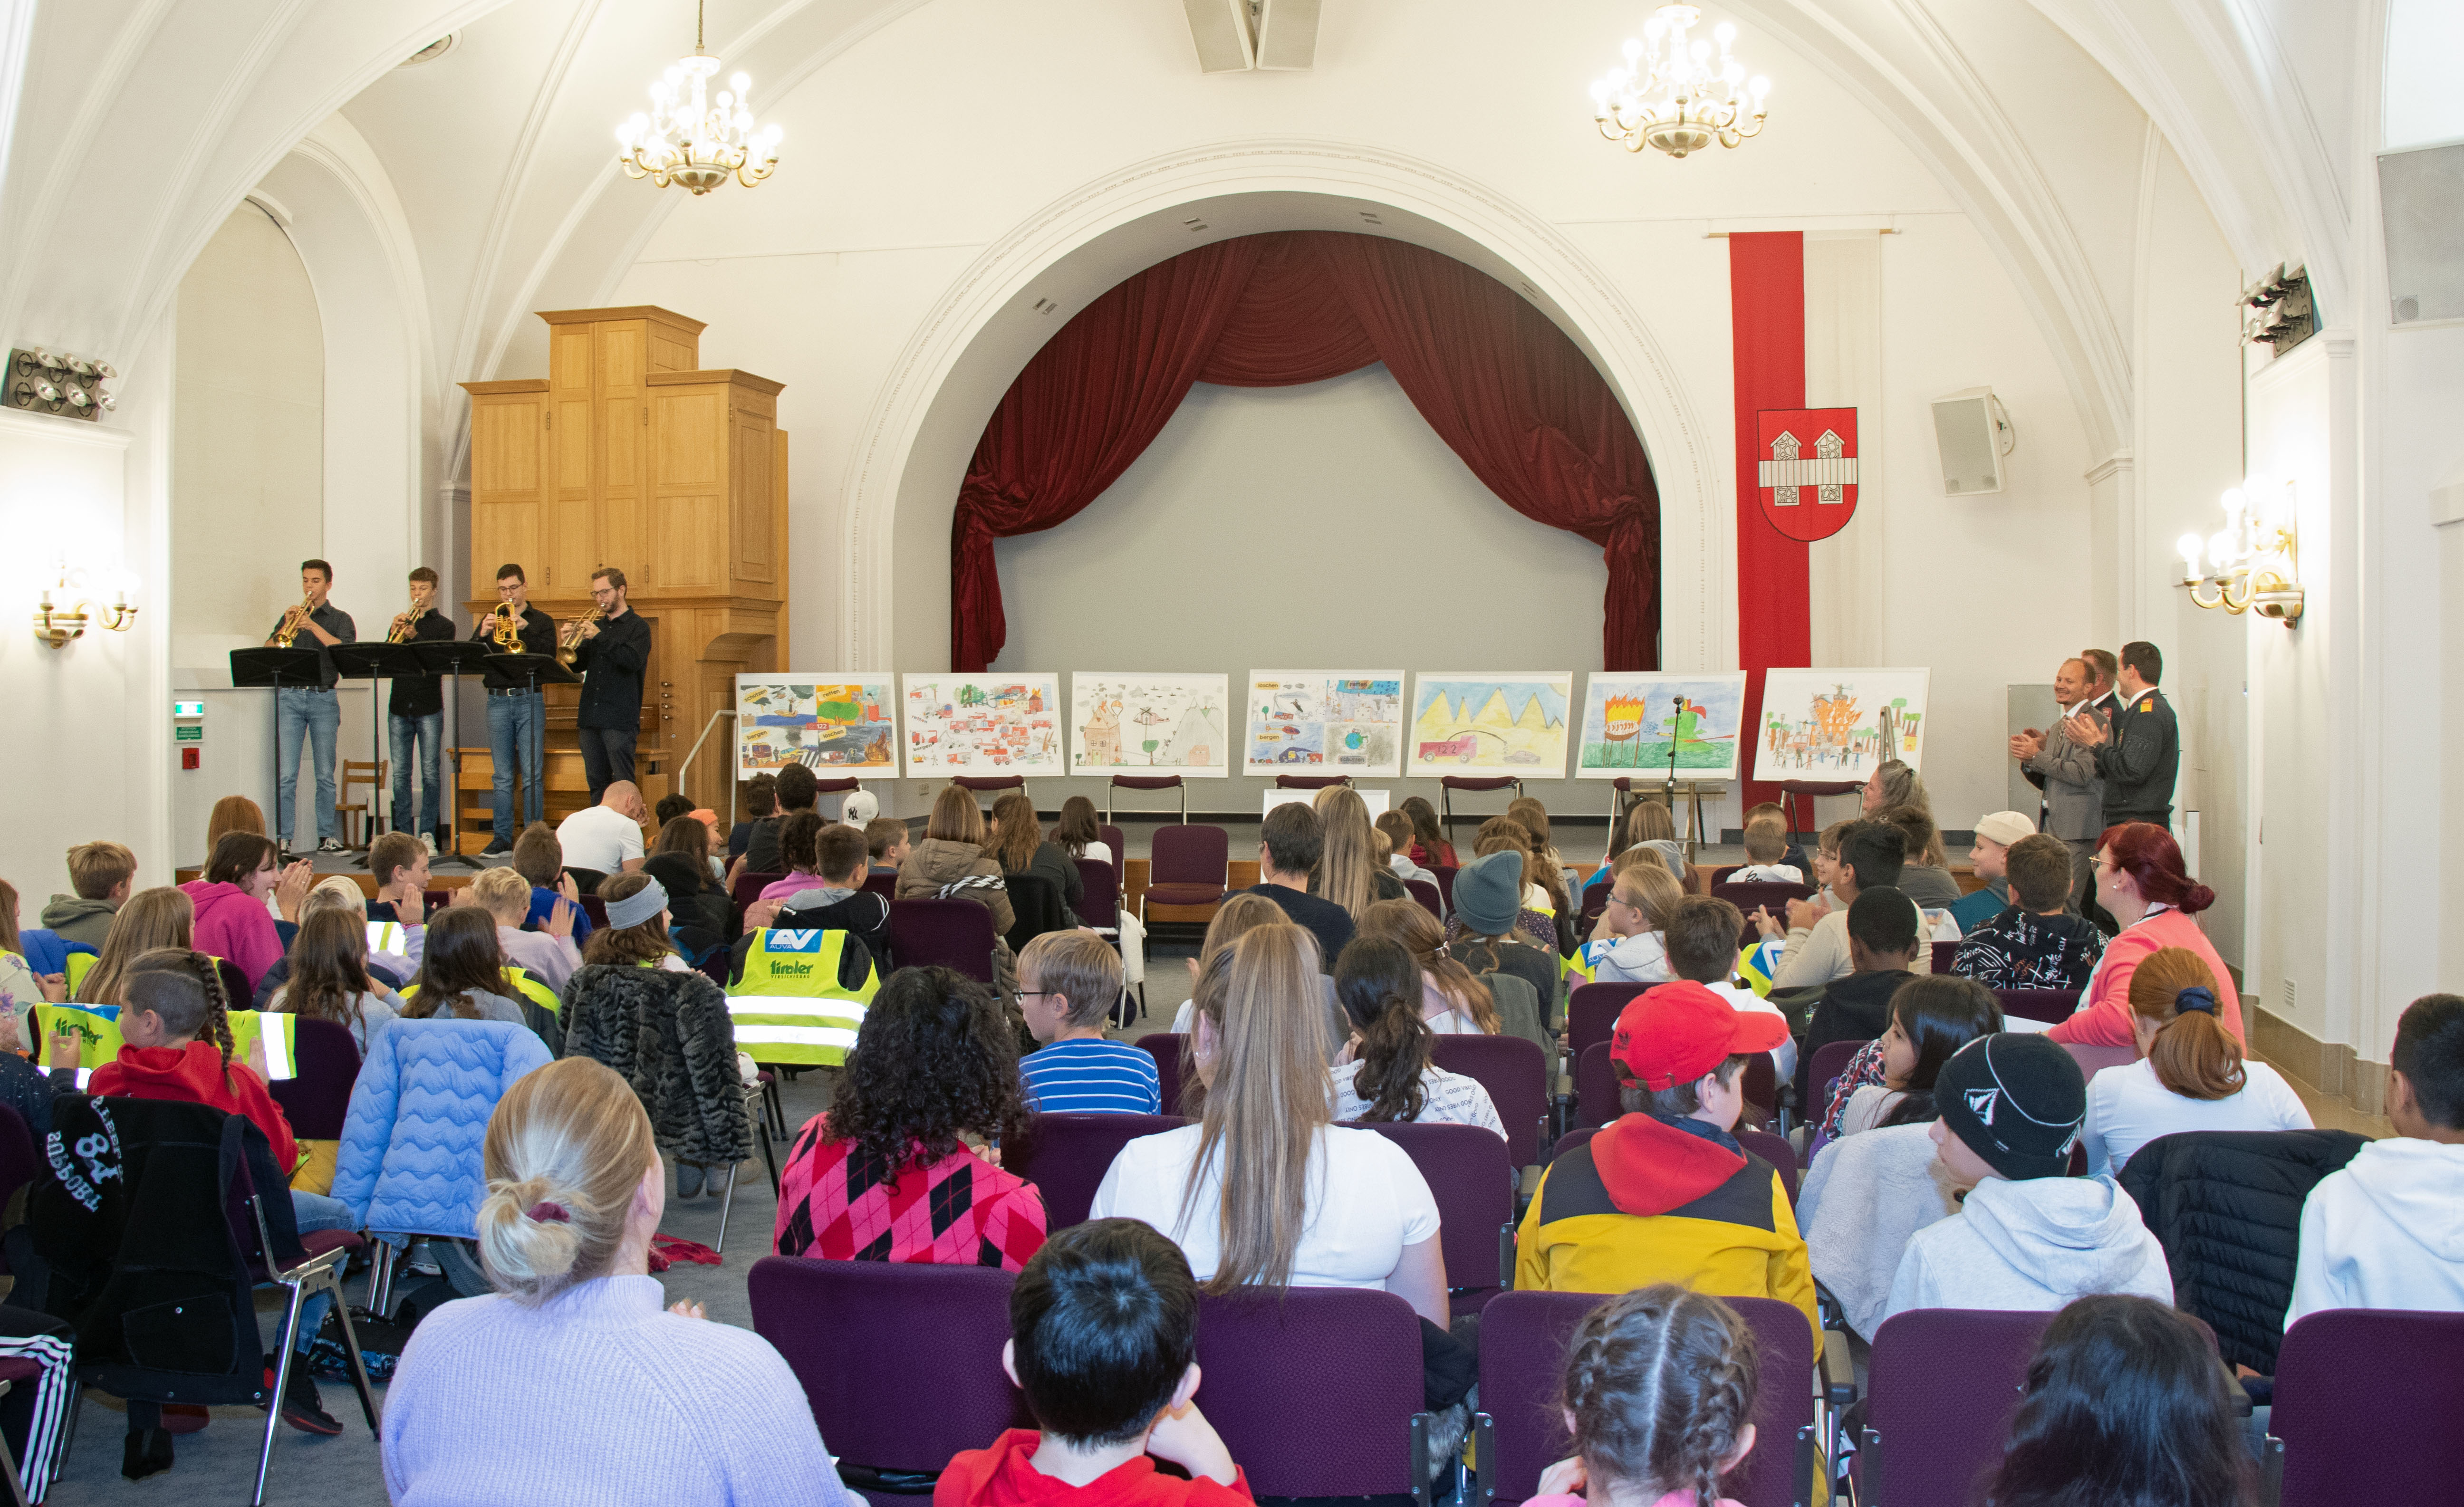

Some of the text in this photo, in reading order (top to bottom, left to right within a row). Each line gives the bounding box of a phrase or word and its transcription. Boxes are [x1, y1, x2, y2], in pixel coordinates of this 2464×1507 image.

[747, 731, 767, 740] bergen
[848, 807, 858, 820] NY
[770, 960, 814, 974] tiroler
[1340, 1089, 1355, 1098] GOOD
